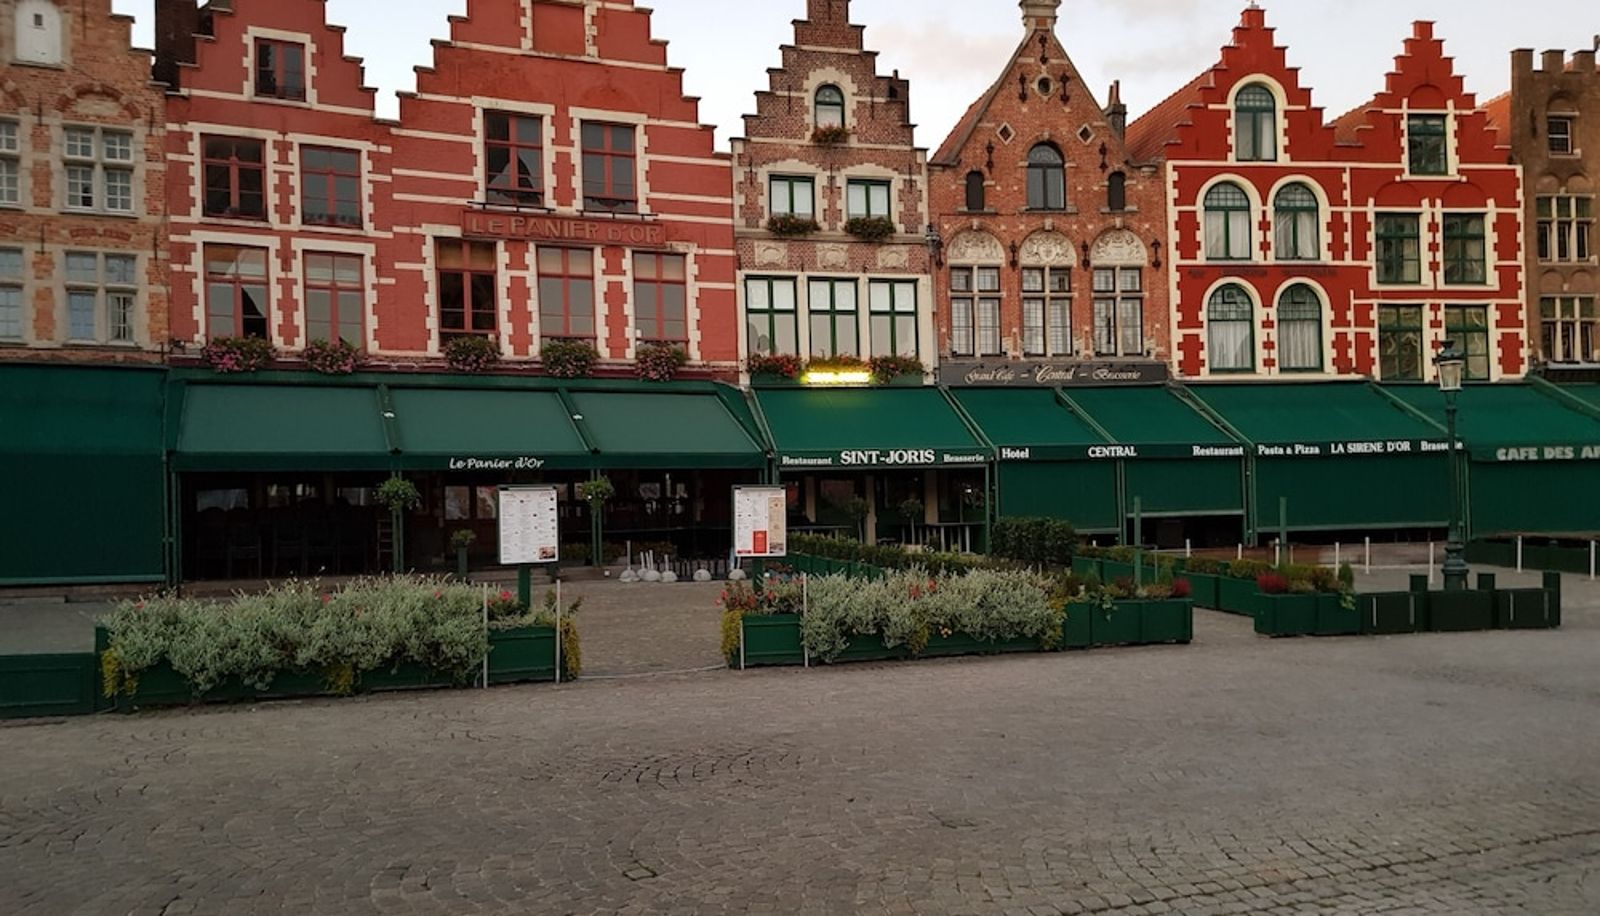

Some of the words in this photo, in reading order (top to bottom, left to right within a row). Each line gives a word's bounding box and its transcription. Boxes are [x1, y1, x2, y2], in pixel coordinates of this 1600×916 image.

[510, 216, 599, 239] PANIER
[608, 224, 660, 243] D'OR
[1034, 365, 1075, 383] Central
[1092, 368, 1142, 381] Brasserie
[1001, 448, 1030, 459] Hotel
[1087, 446, 1137, 458] CENTRAL
[1192, 445, 1244, 456] Restaurant
[1258, 444, 1284, 455] Pasta
[1294, 443, 1320, 455] Pizza
[1330, 443, 1345, 454] LA
[1346, 442, 1385, 453] SIRENE
[1386, 440, 1412, 452] D'OR
[1496, 446, 1539, 461] CAFE
[1543, 445, 1575, 460] DES
[449, 457, 466, 469] Le
[466, 458, 513, 469] Panier
[514, 456, 545, 469] d'Or
[781, 455, 833, 466] Restaurant
[839, 449, 936, 465] SINT-JORIS
[943, 453, 985, 463] Brasserie
